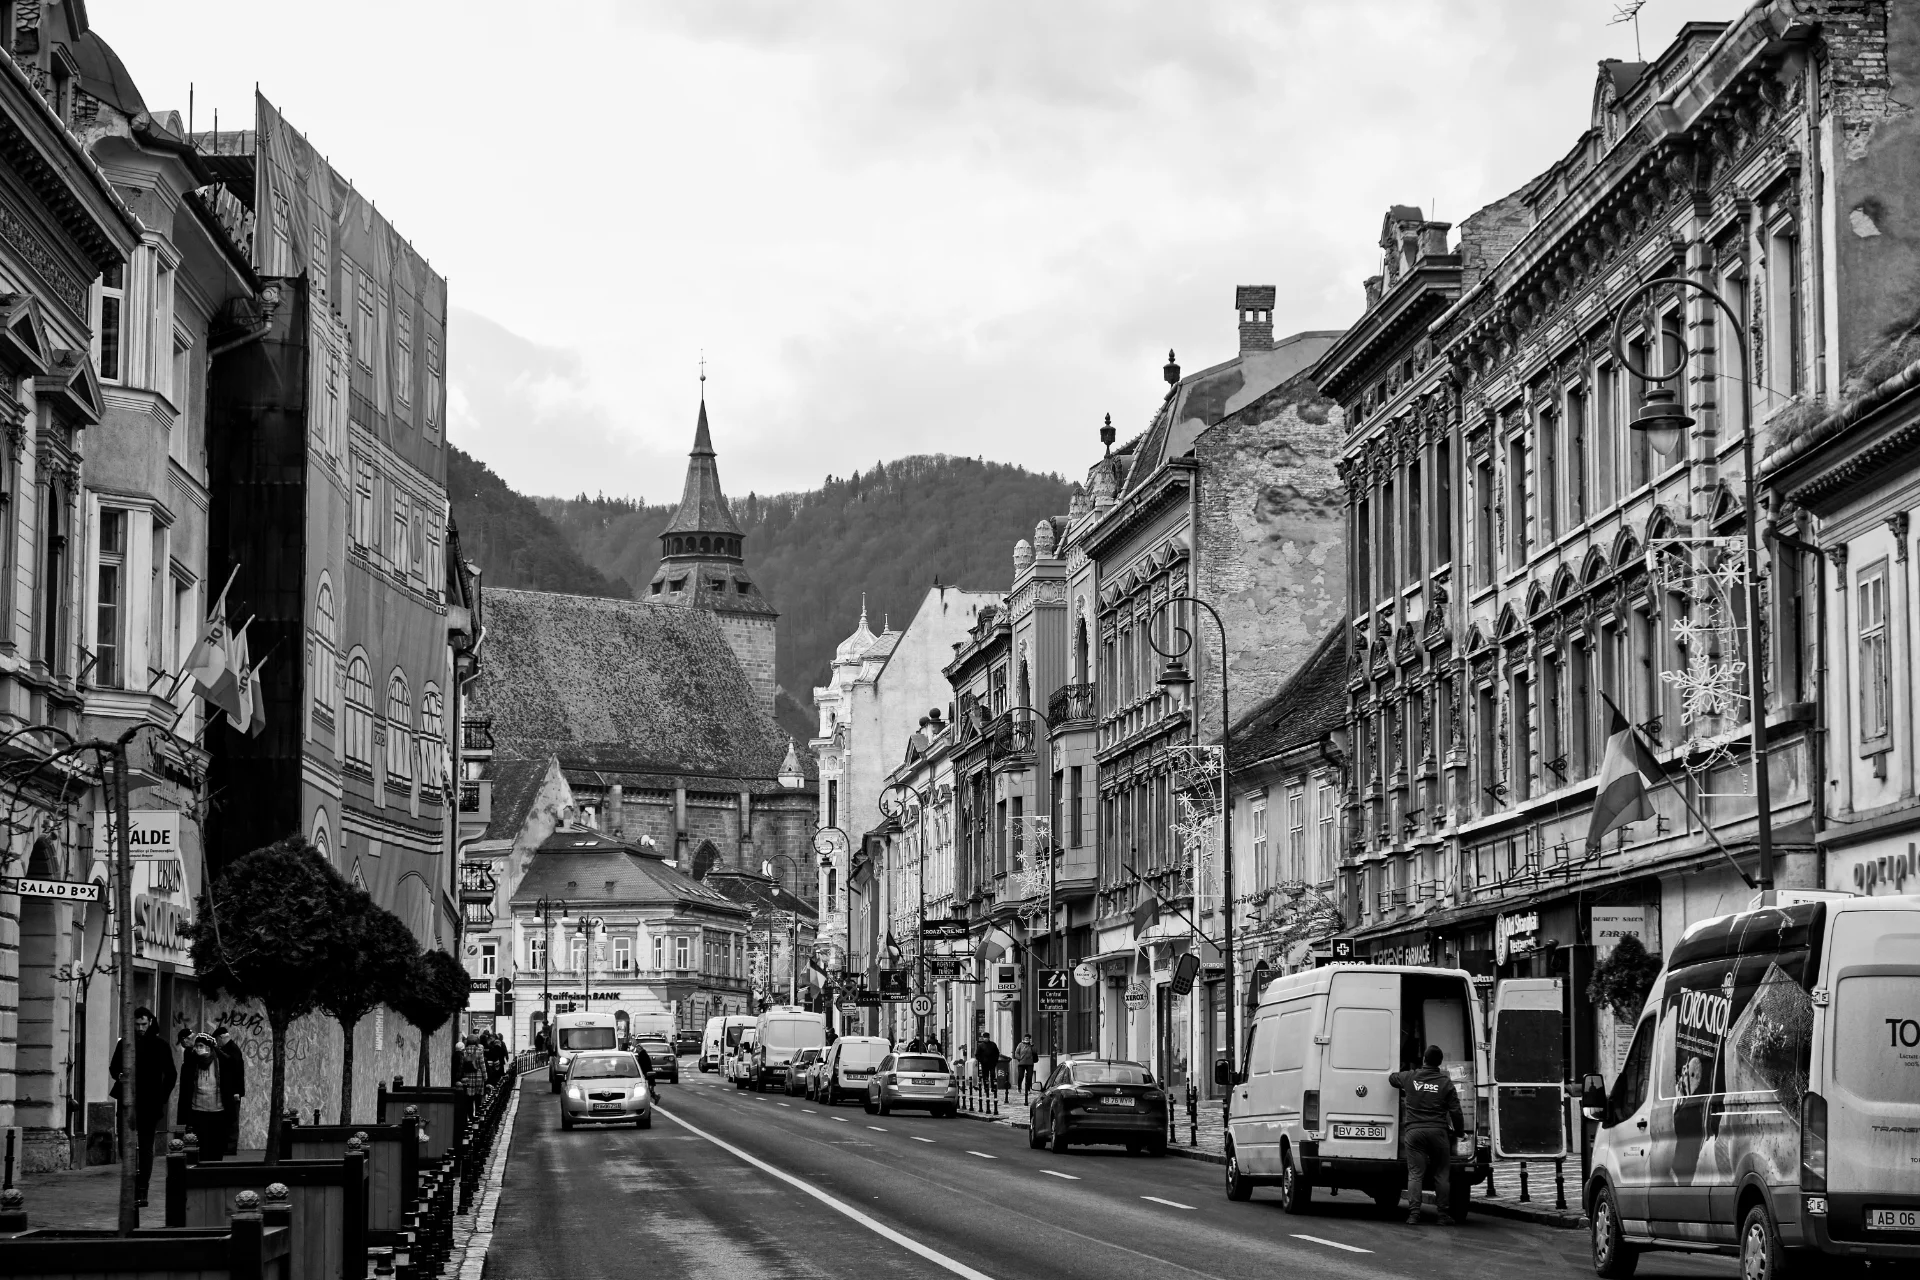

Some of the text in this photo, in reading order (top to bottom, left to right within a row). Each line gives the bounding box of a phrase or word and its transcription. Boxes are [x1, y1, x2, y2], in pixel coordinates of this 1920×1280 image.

[130, 830, 171, 845] ALDE
[1854, 842, 1920, 896] optipl
[20, 881, 66, 895] SALAD
[1506, 911, 1539, 937] Old Shanghai
[1405, 944, 1430, 967] FARMACIE
[592, 992, 621, 1000] BANK
[1125, 994, 1144, 1002] XEROX
[916, 1001, 928, 1011] 30
[1886, 1018, 1920, 1047] TO
[1339, 1127, 1383, 1137] BV 26 BGI
[1877, 1211, 1895, 1226] AB
[1899, 1212, 1916, 1226] 06
